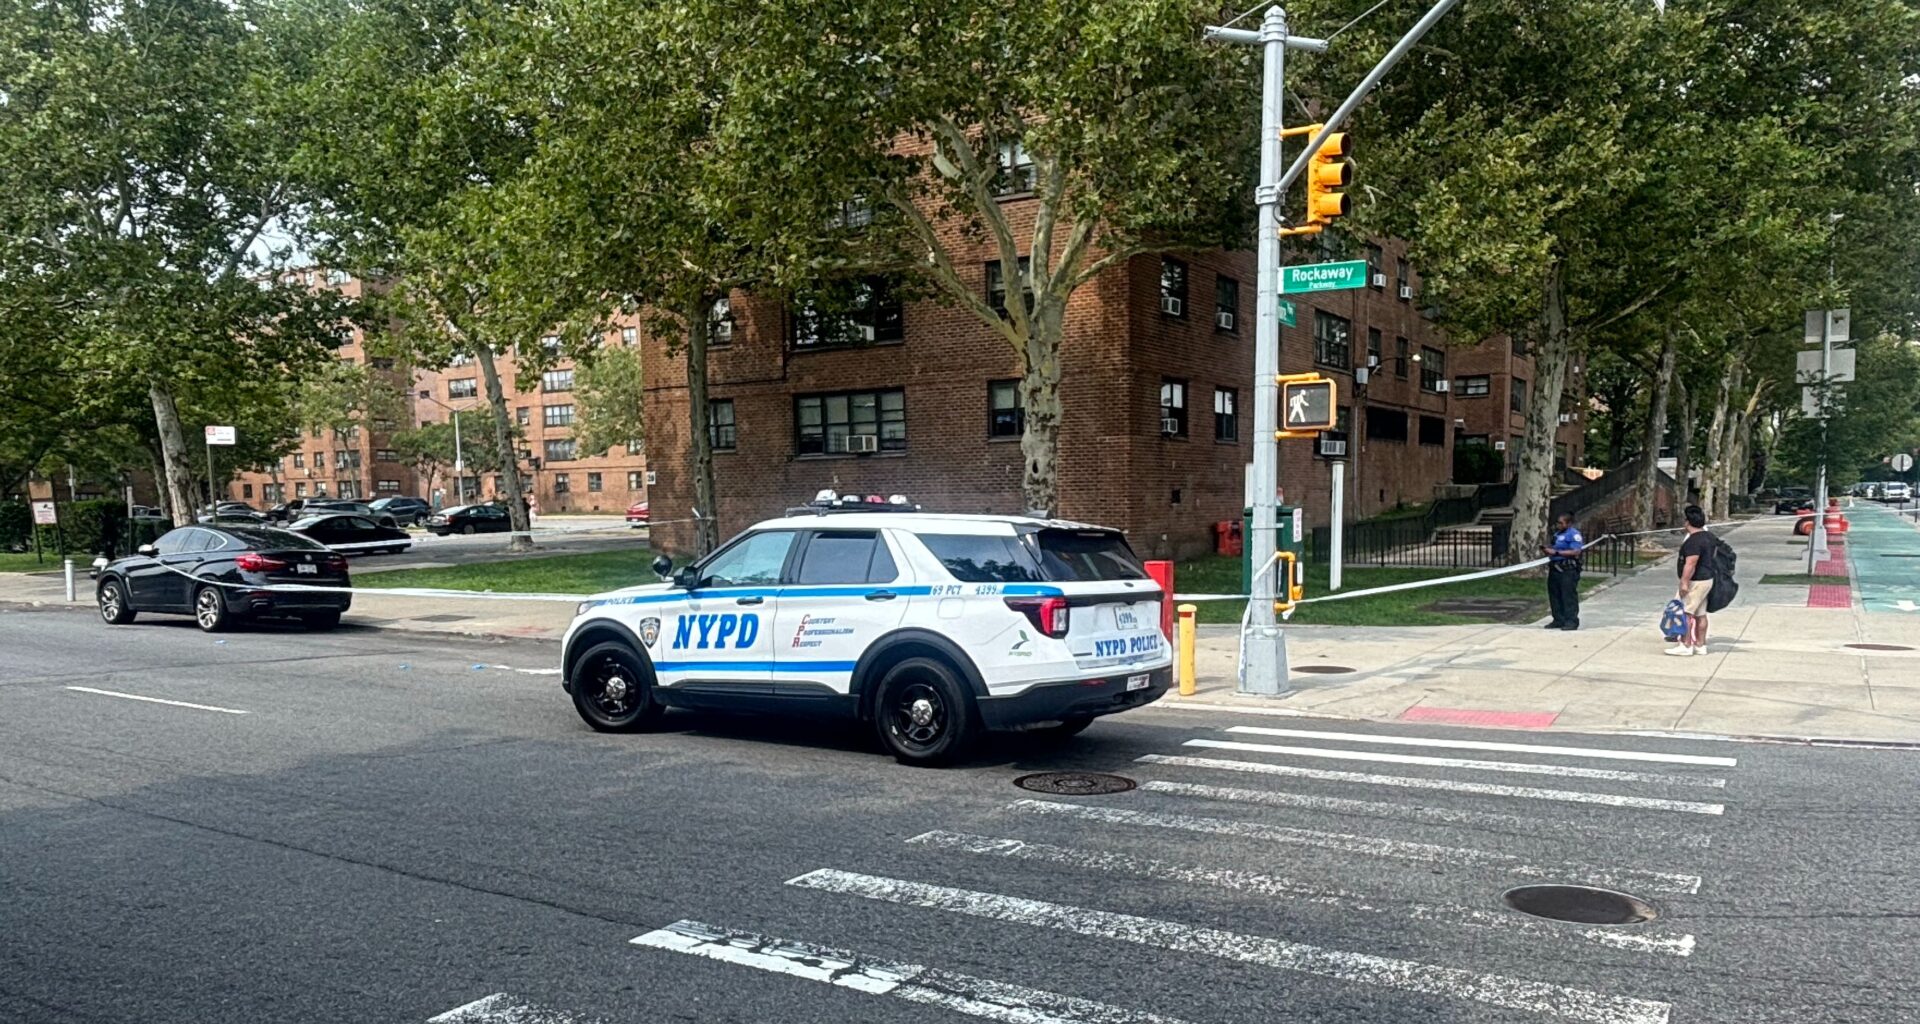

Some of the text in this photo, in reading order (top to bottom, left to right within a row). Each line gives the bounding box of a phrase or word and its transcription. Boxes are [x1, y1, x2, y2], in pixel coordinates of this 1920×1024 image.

[1292, 267, 1354, 282] Rockaway
[1308, 281, 1336, 289] Parkway
[932, 585, 962, 595] 69 PCT
[975, 585, 997, 595] 4399
[672, 613, 759, 649] NYPD
[1095, 634, 1158, 657] NYPD POLICE
